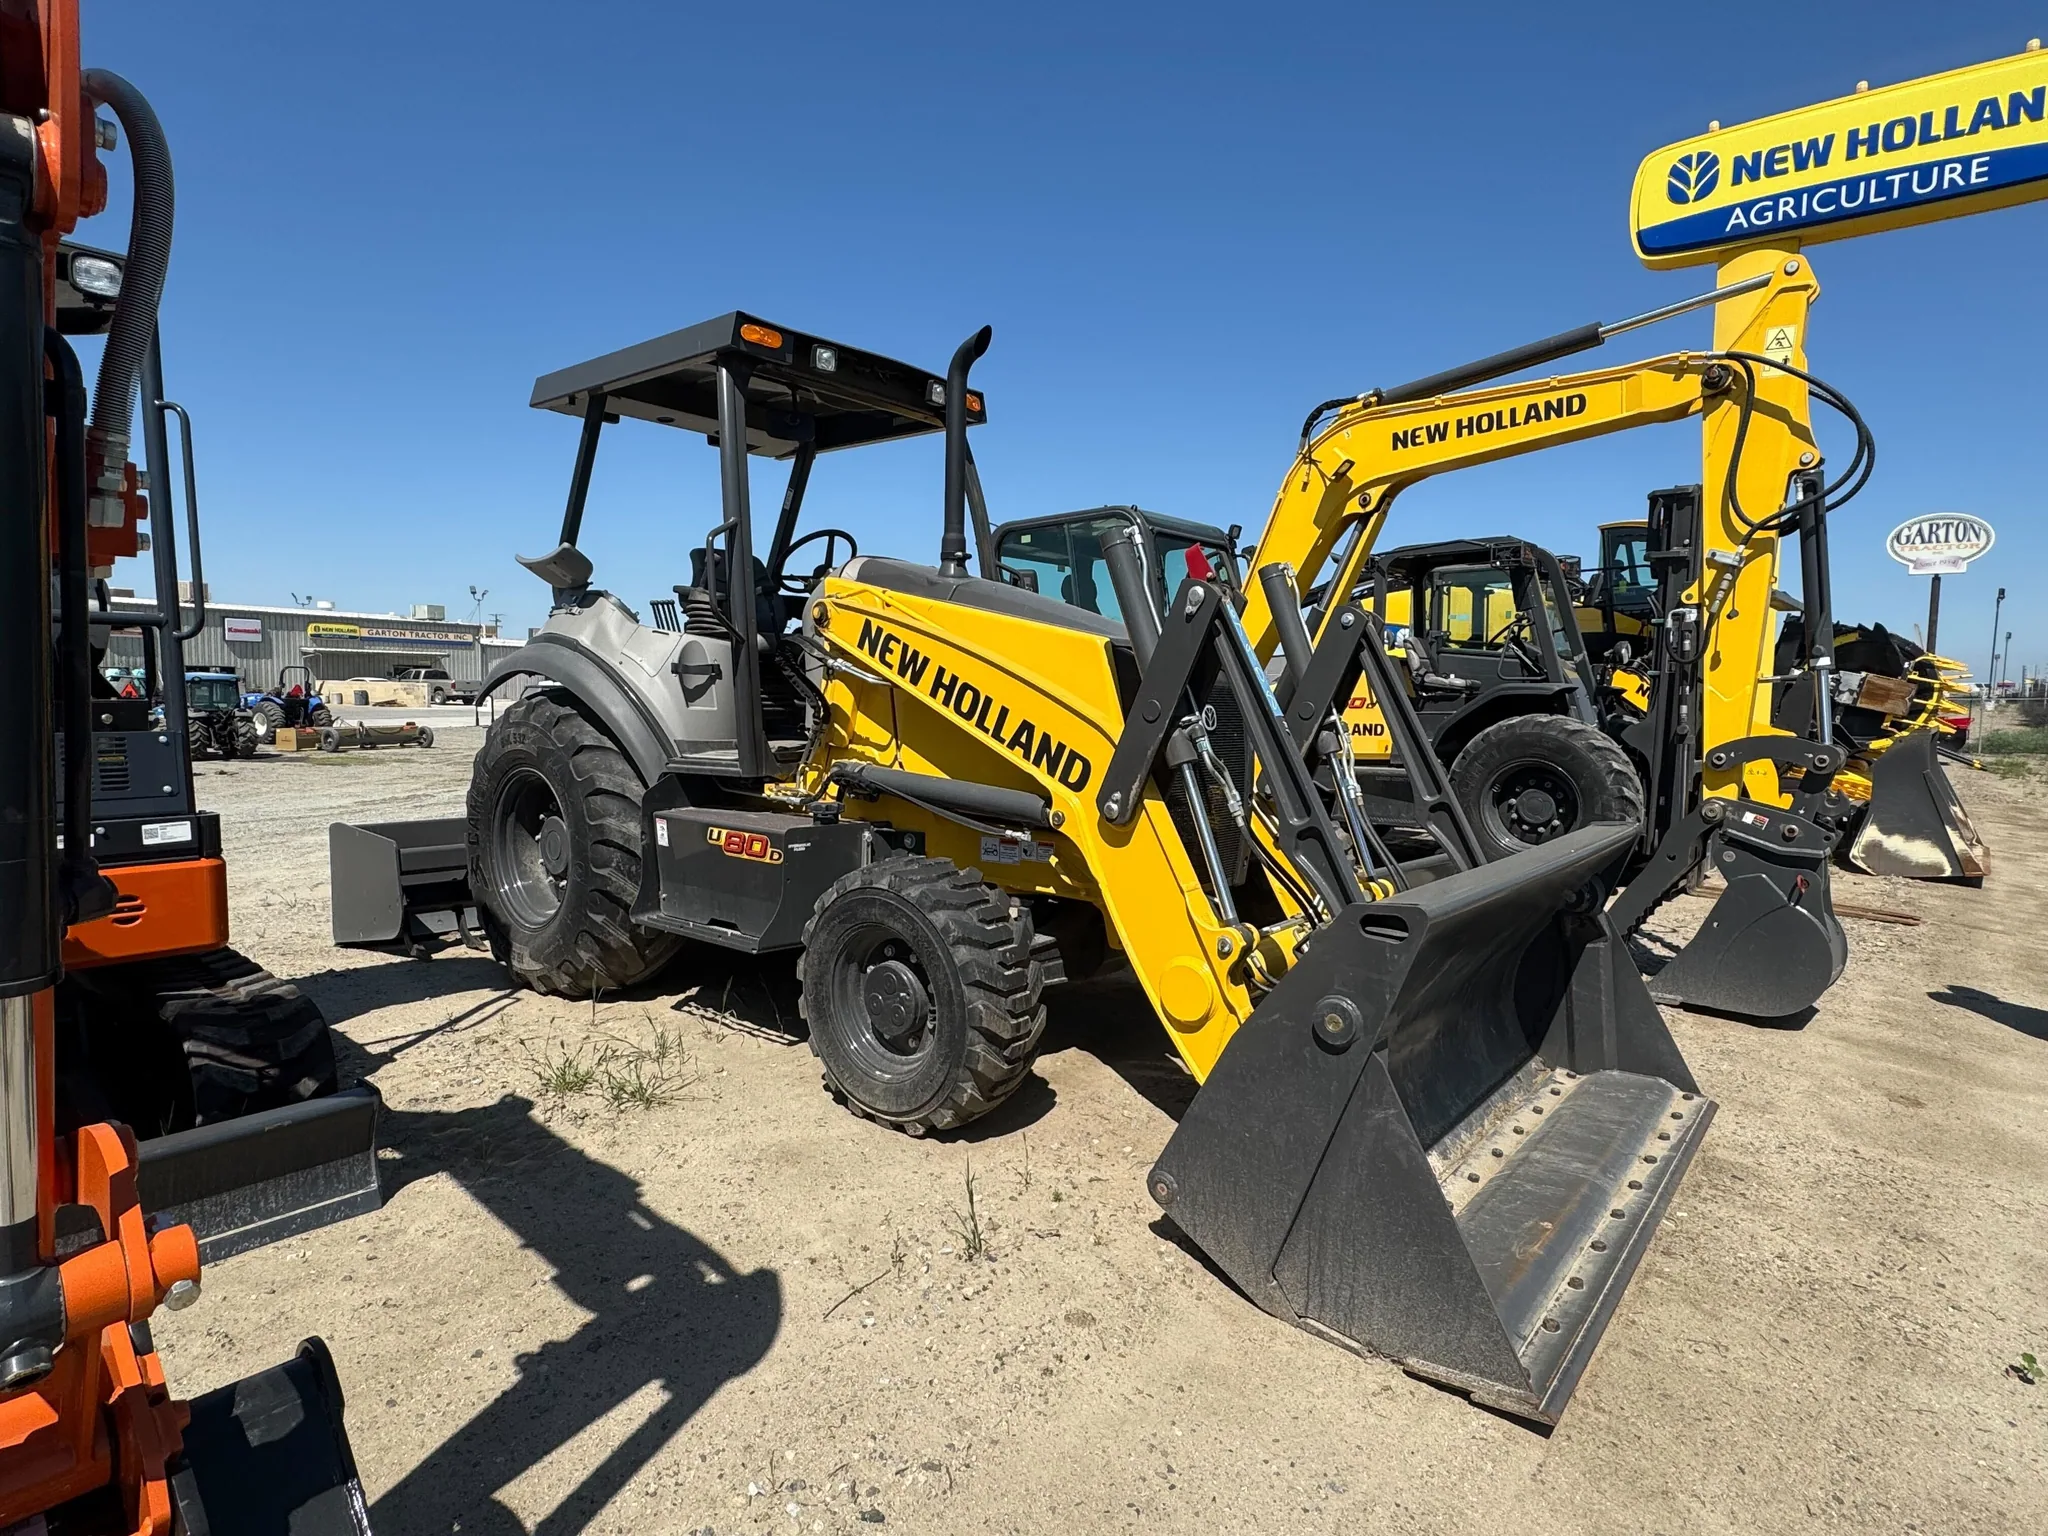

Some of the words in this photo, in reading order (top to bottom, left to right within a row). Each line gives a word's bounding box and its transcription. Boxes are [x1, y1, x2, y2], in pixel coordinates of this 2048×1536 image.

[1731, 133, 1835, 186] NEW
[1846, 86, 2048, 161] HOLLAN
[1725, 157, 1990, 231] AGRICULTURE
[1392, 421, 1449, 451] NEW
[1456, 393, 1587, 438] HOLLAND
[1896, 521, 1982, 545] GARTON
[1897, 543, 1981, 552] TRACTOR
[368, 629, 406, 638] GARTON
[857, 618, 930, 687] NEW
[929, 665, 1092, 793] HOLLAND
